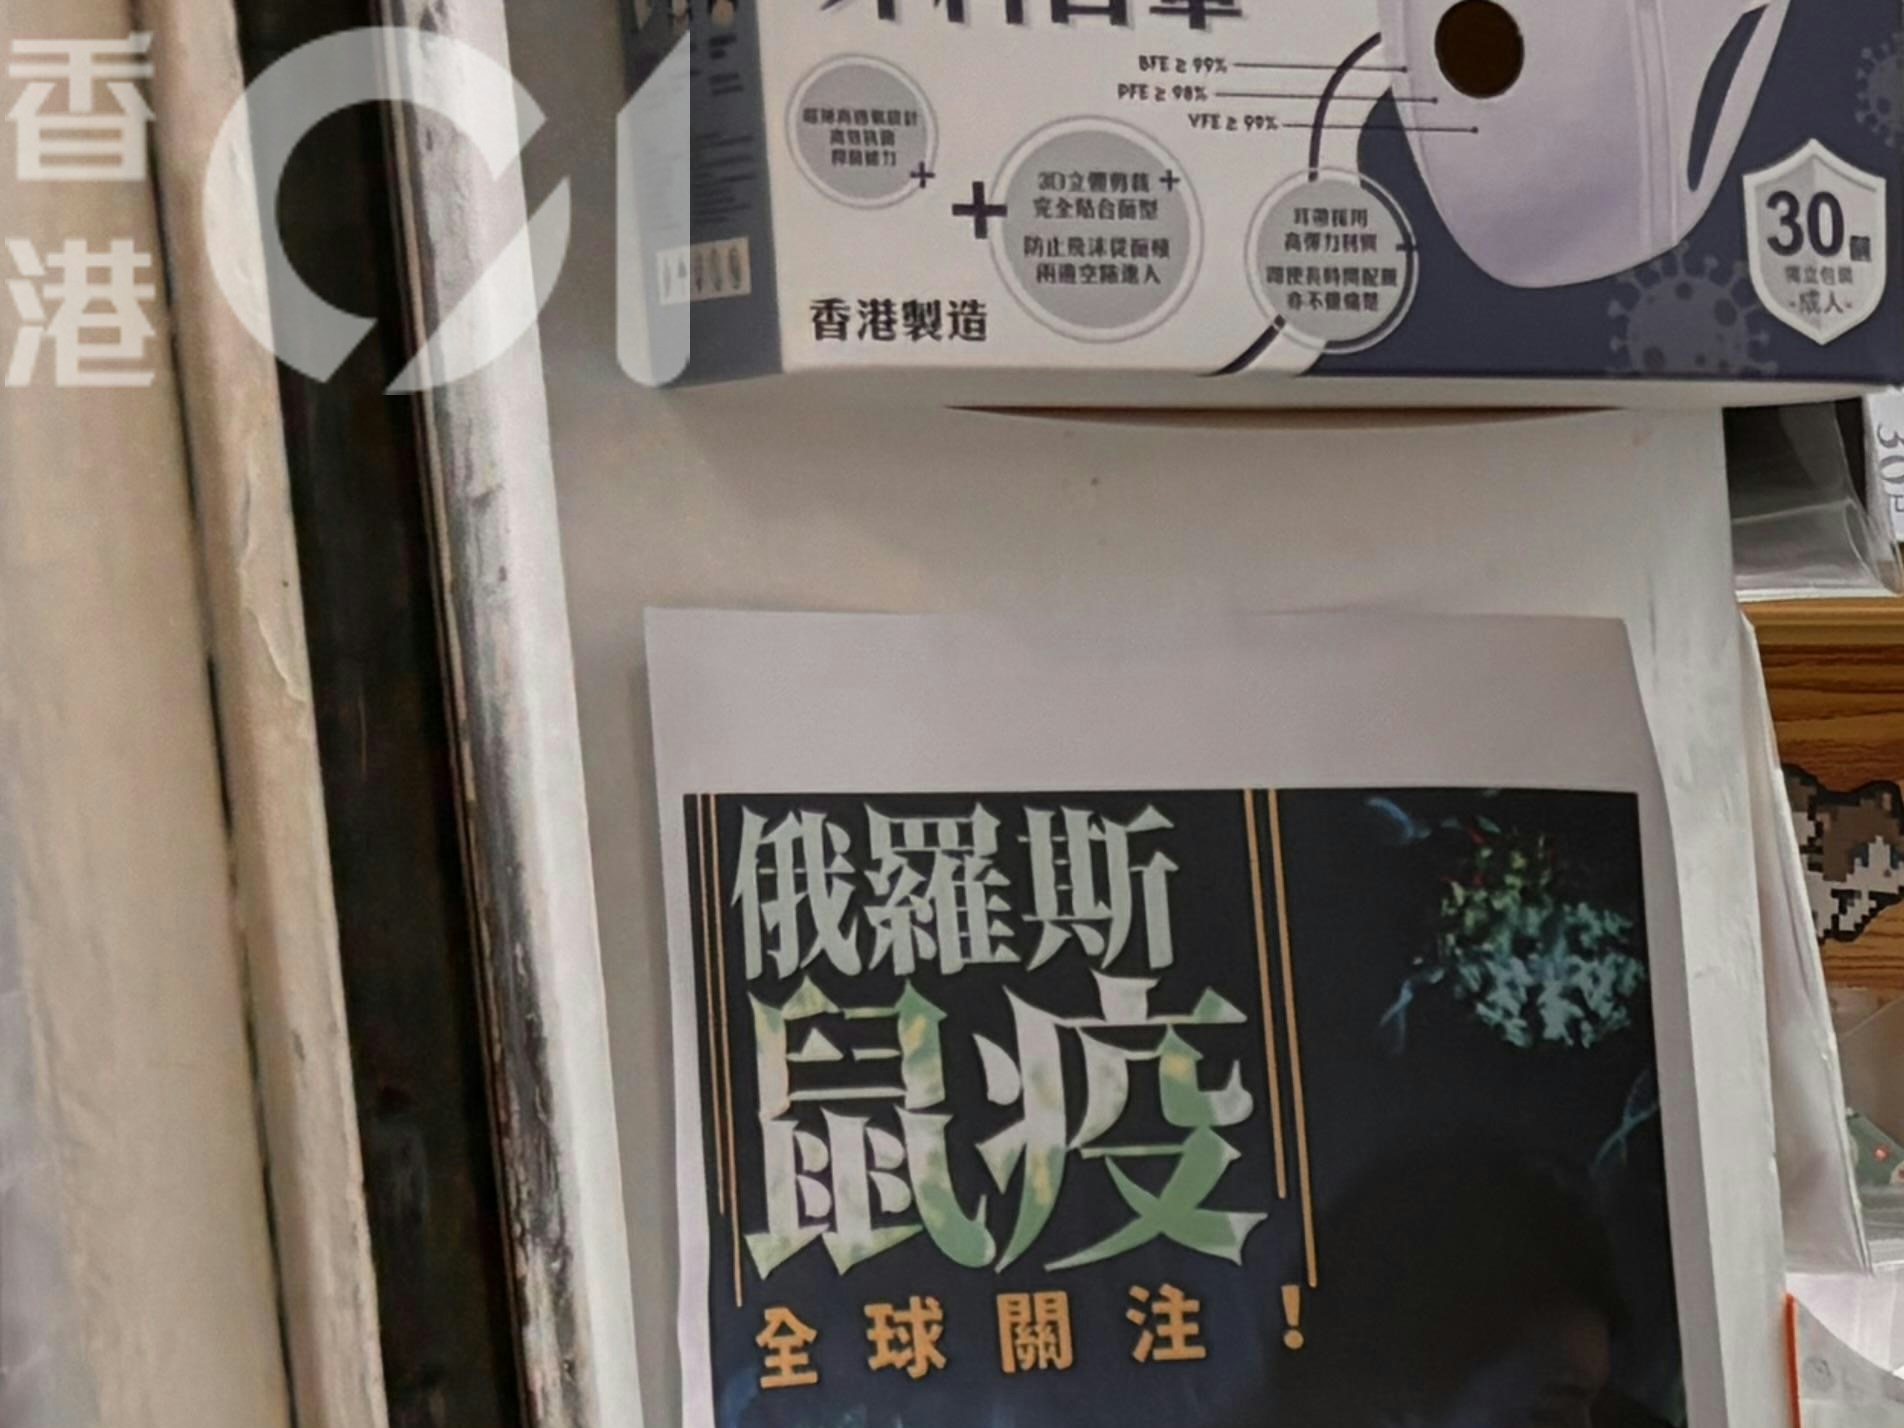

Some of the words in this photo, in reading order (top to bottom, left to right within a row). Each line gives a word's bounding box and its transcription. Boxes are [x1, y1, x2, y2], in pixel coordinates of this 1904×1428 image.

[1192, 56, 1228, 74] 99%
[1118, 83, 1149, 99] PFE
[809, 298, 988, 343] 香港製造
[730, 802, 1180, 980] 俄羅斯
[743, 967, 1269, 1280] 鼠疫
